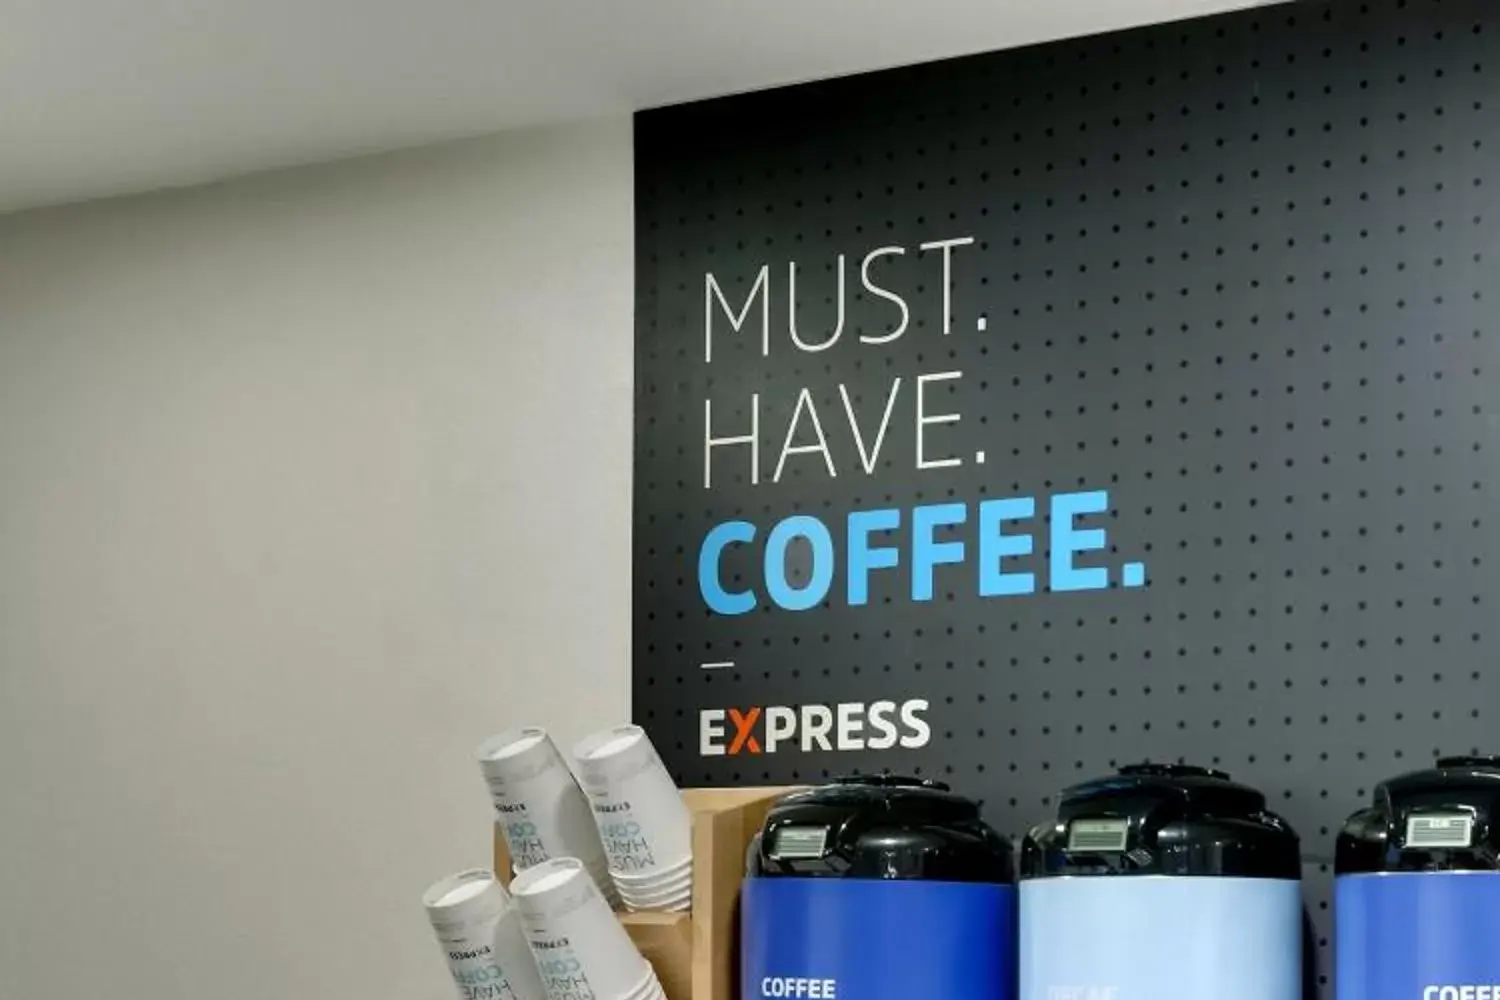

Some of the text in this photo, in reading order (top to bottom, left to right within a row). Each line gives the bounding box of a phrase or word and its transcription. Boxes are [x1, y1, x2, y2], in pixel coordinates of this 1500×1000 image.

[705, 236, 987, 363] MUST.
[704, 371, 985, 489] HAVE.
[699, 490, 1145, 615] COFFEE.
[701, 699, 931, 756] EXPRESS
[762, 977, 836, 999] COFFEE
